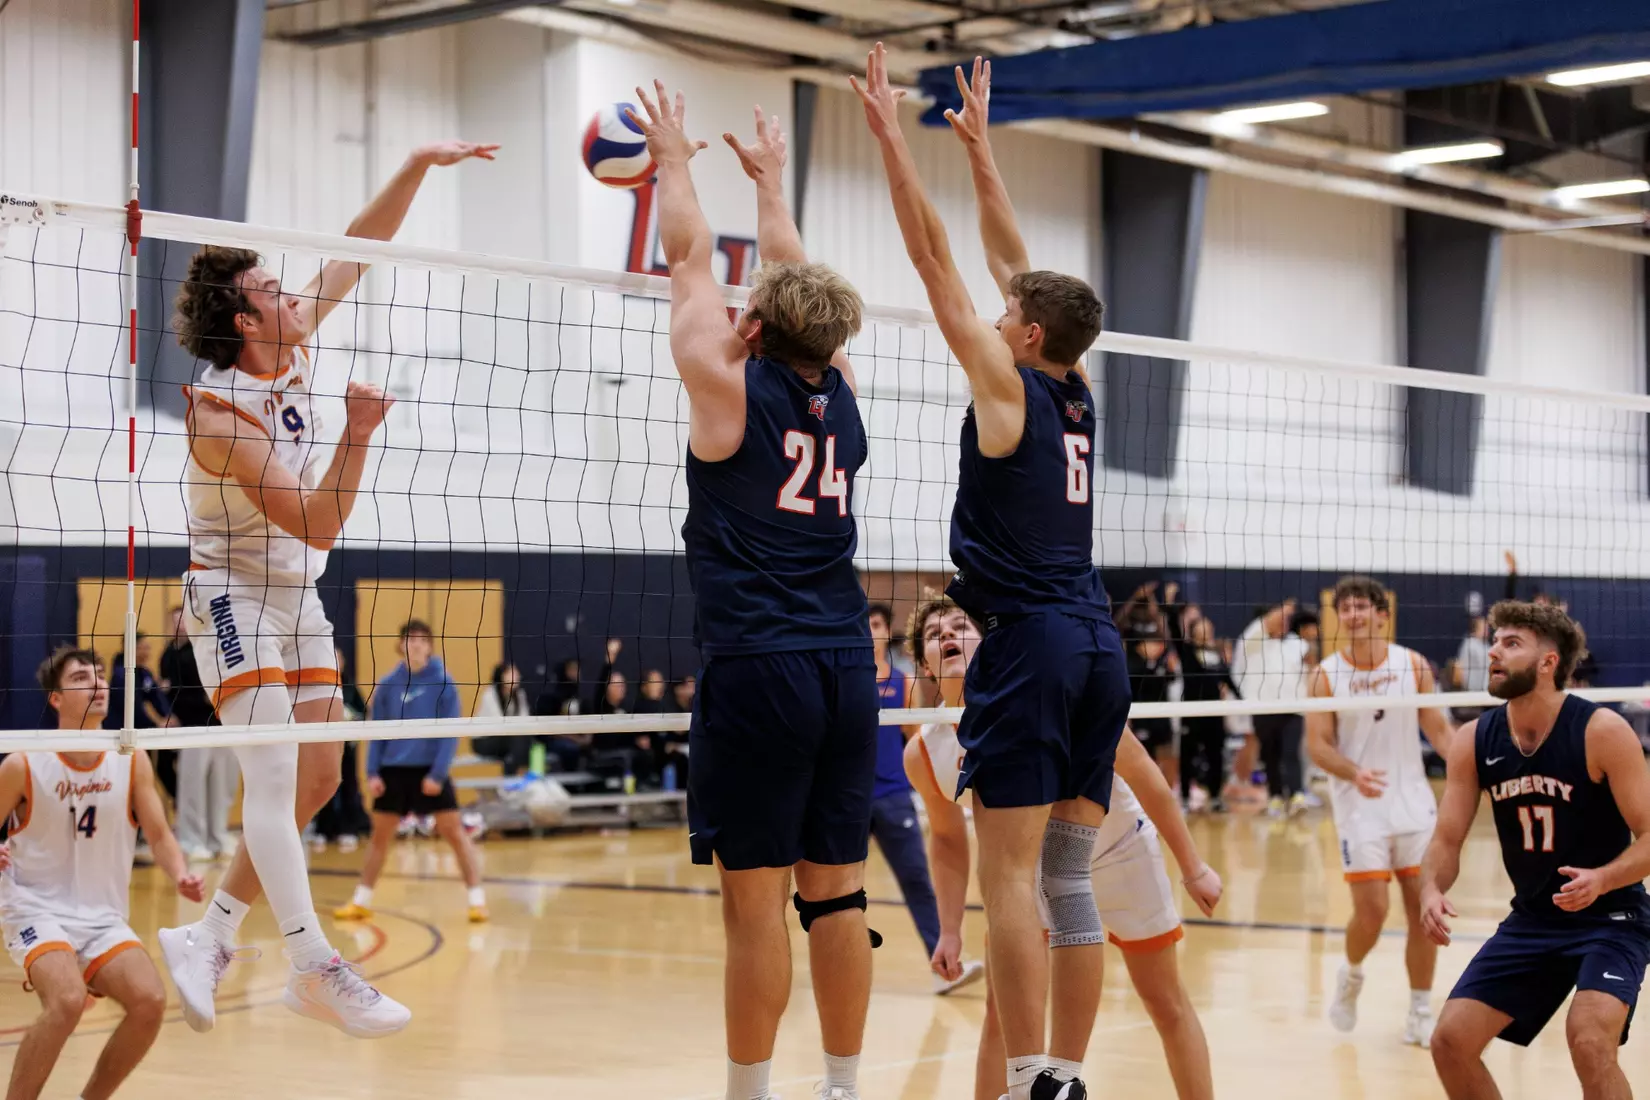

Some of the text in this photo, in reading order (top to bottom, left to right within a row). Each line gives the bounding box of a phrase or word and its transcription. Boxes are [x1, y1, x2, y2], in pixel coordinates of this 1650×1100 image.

[9, 197, 38, 208] Senoh
[281, 405, 305, 446] 9
[776, 428, 848, 517] 24
[1062, 431, 1090, 504] 6
[1491, 774, 1574, 802] LIBERTY
[1517, 805, 1555, 852] 17
